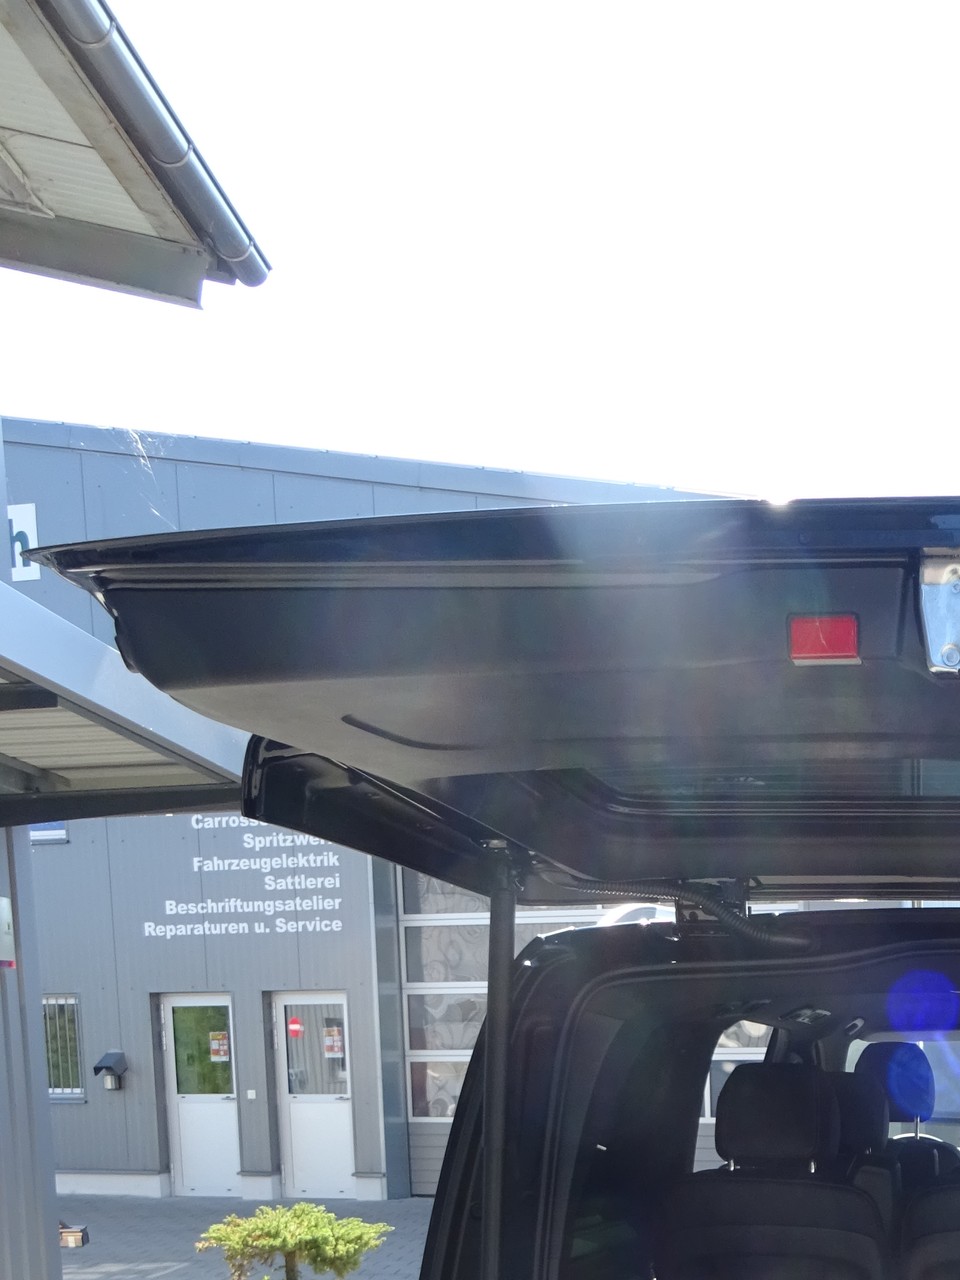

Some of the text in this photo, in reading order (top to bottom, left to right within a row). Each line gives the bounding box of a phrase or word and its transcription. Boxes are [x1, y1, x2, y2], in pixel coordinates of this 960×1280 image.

[193, 852, 340, 872] Fahrzeugelektrik
[264, 873, 341, 890] Sattlerei
[165, 897, 342, 915] Beschriftungsatelier
[144, 917, 343, 939] Reparaturen u. Service
